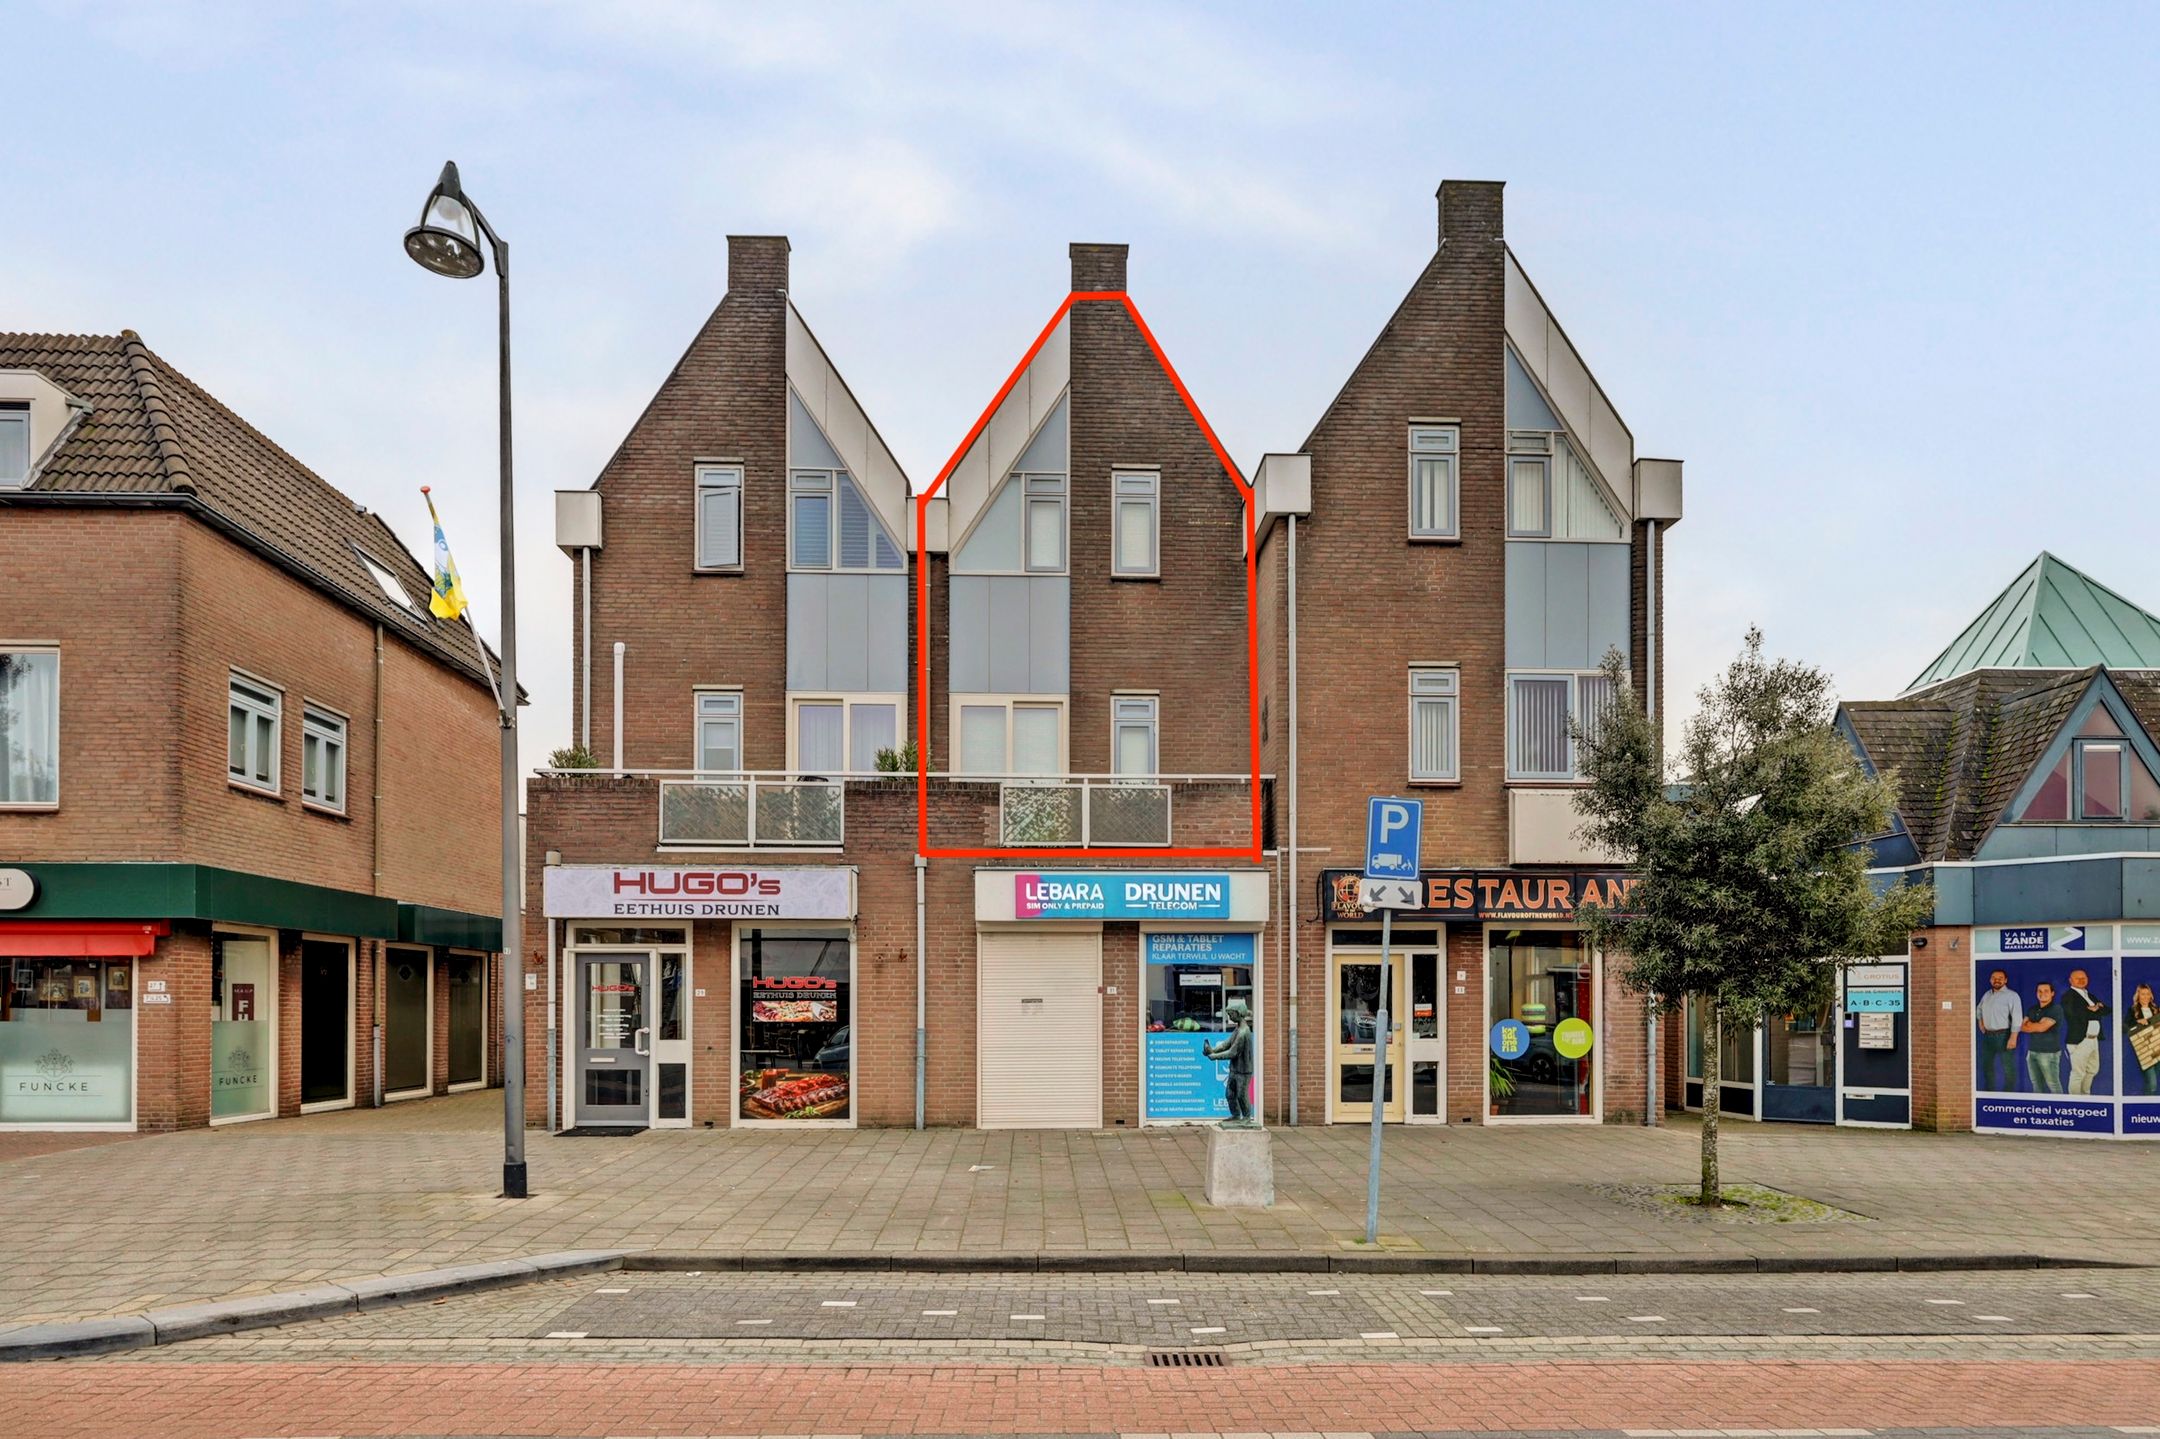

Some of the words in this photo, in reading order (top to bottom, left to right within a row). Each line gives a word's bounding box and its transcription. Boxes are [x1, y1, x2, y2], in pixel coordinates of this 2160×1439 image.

[1380, 804, 1409, 844] P
[613, 872, 781, 895] HUGO's
[1025, 883, 1104, 900] LEBARA
[1125, 883, 1221, 901] DRUNEN
[614, 904, 695, 916] EETHUIS
[702, 904, 780, 916] DRUNEN
[1026, 902, 1040, 910] SIM
[1041, 902, 1062, 910] ONLY
[1064, 902, 1071, 910] &
[1071, 902, 1105, 910] PREPAID
[1149, 901, 1198, 910] TELECOM
[1152, 935, 1175, 943] GSM
[1177, 935, 1185, 943] &
[1188, 935, 1224, 944] TABLET
[2004, 936, 2044, 945] ZANDE
[2127, 936, 2160, 944] www.z
[1152, 943, 1213, 952] REPARATIES
[752, 976, 837, 989] HUGO's
[753, 991, 795, 999] EETHUIS
[797, 991, 837, 999] DRUNEN
[219, 1075, 257, 1086] FUNCKE
[19, 1082, 88, 1091] FUNCKE
[1982, 1105, 2052, 1115] commercieel
[2055, 1106, 2107, 1118] vastgoed
[2013, 1116, 2028, 1124] en
[2031, 1116, 2075, 1127] taxaties
